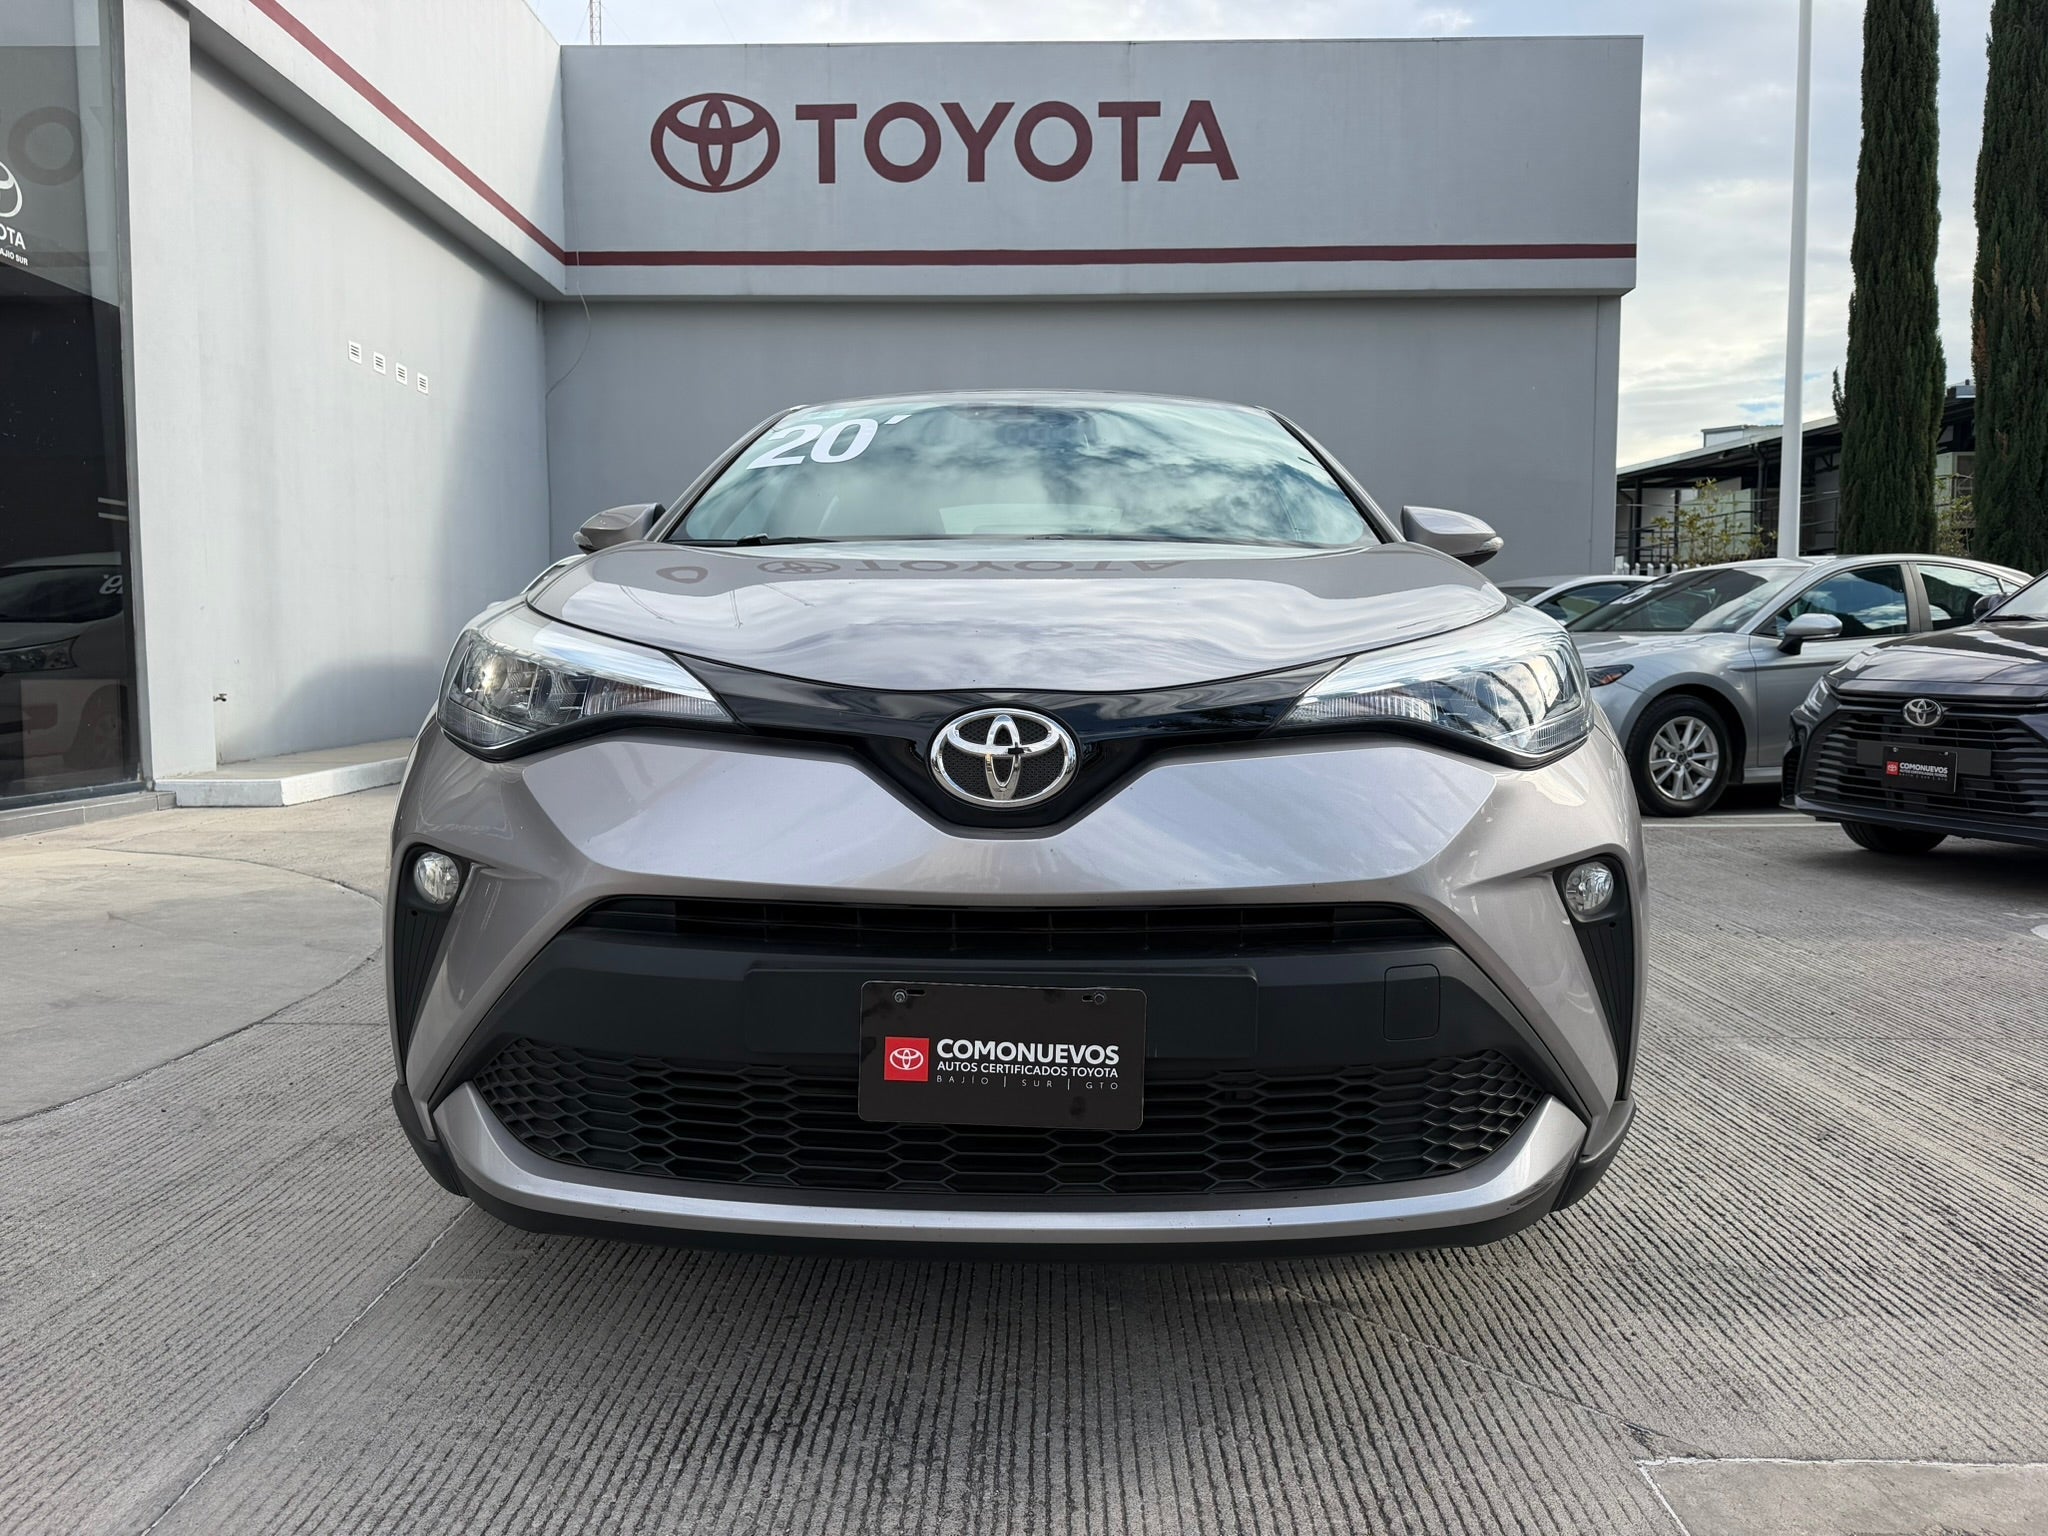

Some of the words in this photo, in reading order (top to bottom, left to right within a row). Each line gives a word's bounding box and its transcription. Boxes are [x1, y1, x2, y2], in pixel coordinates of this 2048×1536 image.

[795, 99, 1239, 185] TOYOTA
[1900, 762, 1948, 774] COMONUEVOS
[937, 1038, 1120, 1065] COMONUEVOS
[937, 1061, 978, 1073] AUTOS
[980, 1062, 1068, 1076] CERTIFICADOS
[1071, 1066, 1119, 1078] TOYOTA
[1021, 1079, 1053, 1088] SUR
[1085, 1081, 1119, 1090] GTO
